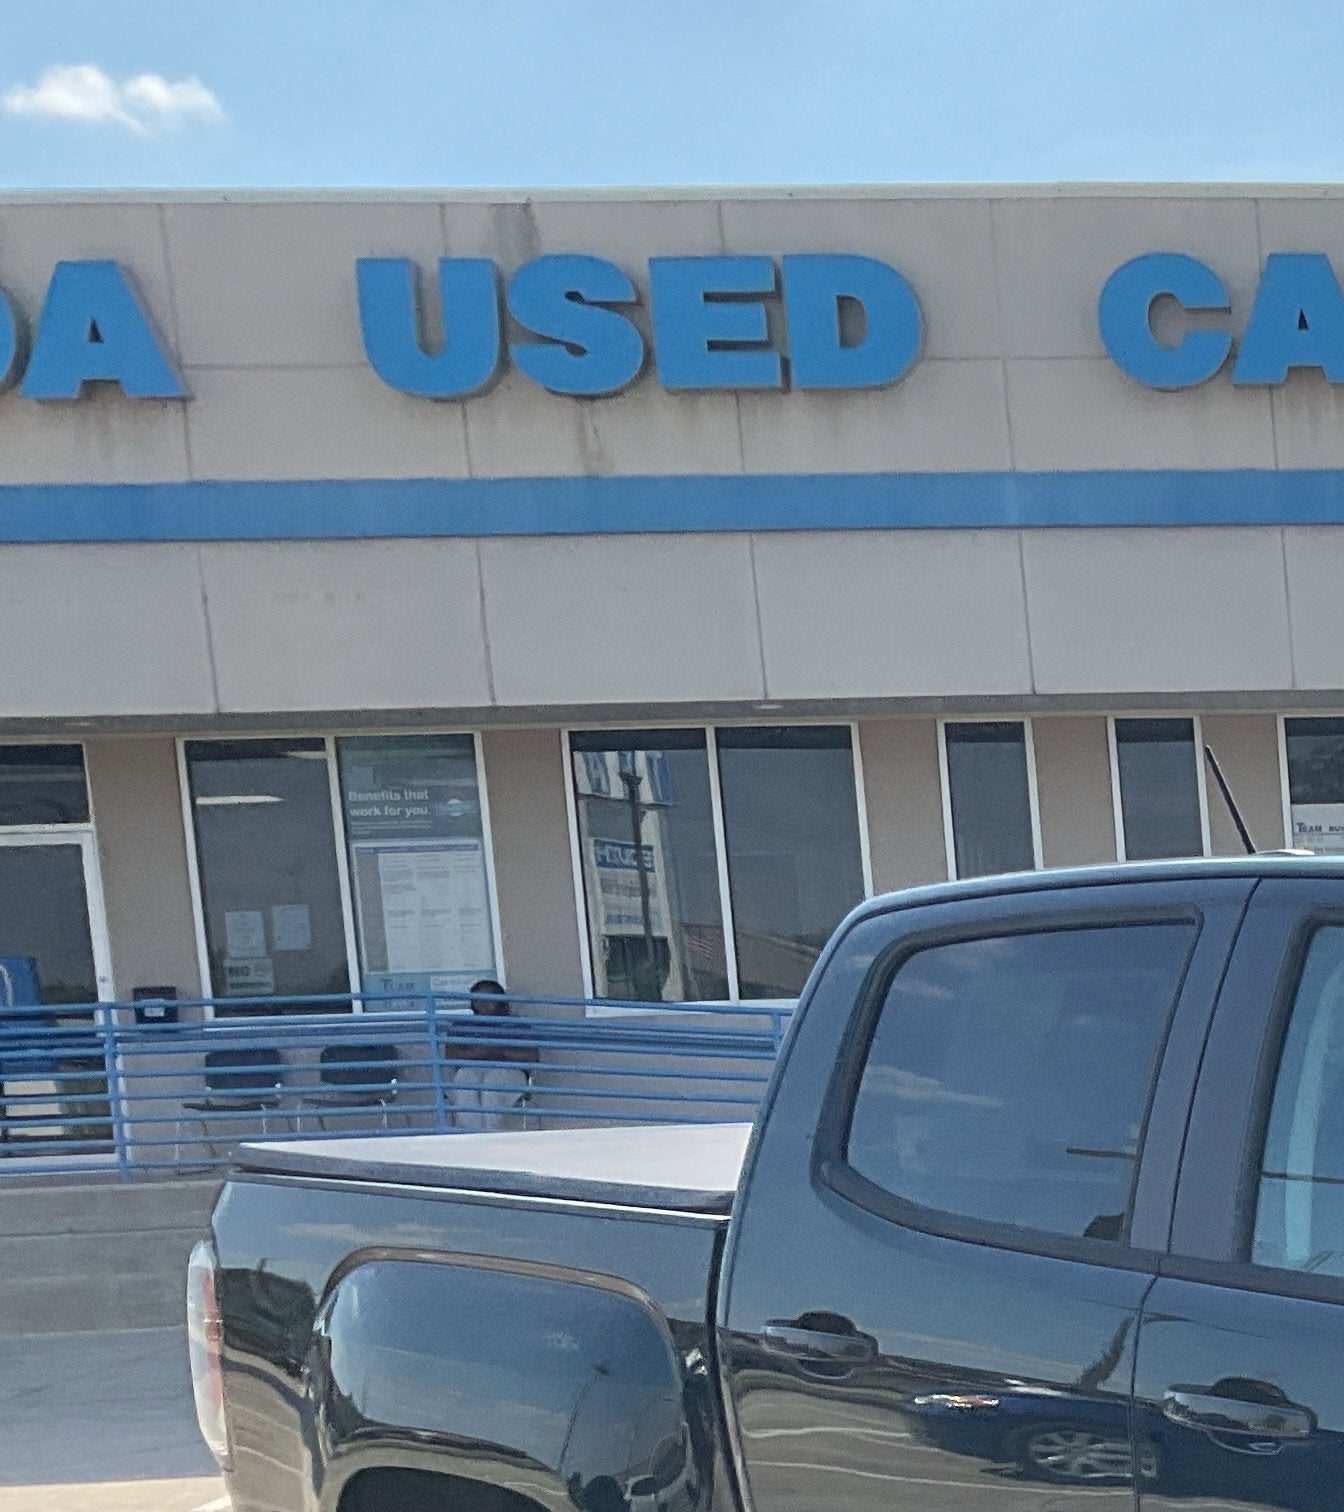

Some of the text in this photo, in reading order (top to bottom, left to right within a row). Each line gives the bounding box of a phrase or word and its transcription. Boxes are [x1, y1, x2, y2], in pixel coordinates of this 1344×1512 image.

[0, 258, 189, 400] A
[355, 253, 923, 401] USED
[348, 788, 429, 801] Benefits that
[349, 806, 380, 817] work
[383, 805, 401, 816] for
